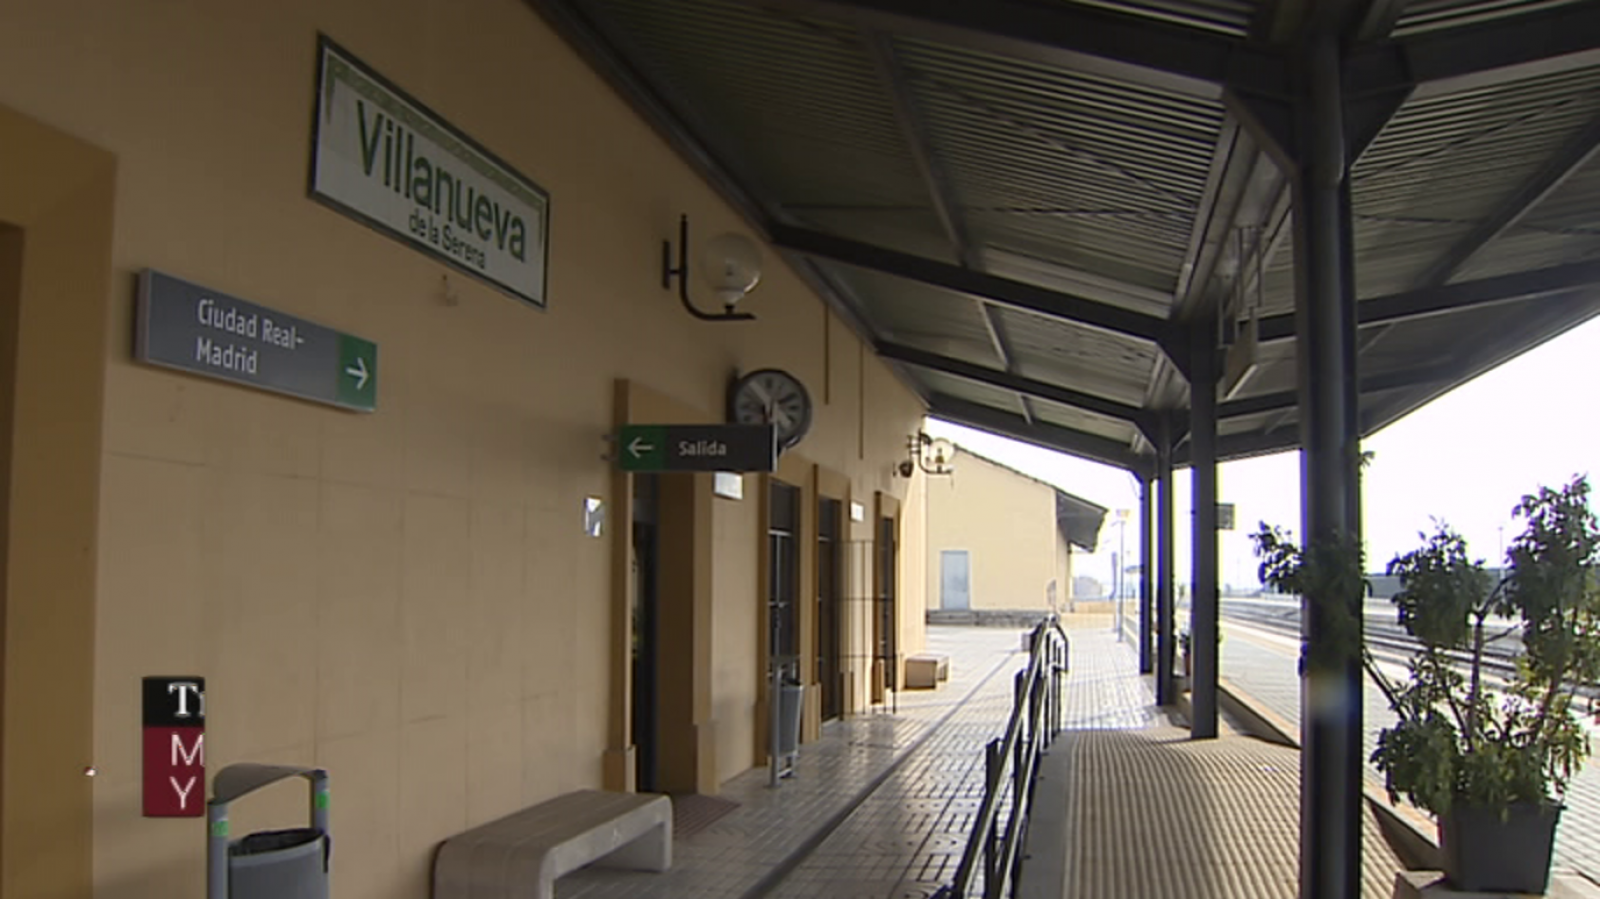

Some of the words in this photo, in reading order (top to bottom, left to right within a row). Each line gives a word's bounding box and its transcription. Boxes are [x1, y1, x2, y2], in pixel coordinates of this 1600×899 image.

[356, 99, 526, 263] Villanueva
[408, 208, 427, 238] de
[428, 214, 439, 245] la
[442, 224, 485, 270] Serena
[198, 298, 258, 338] Ciudad
[262, 317, 304, 350] Real-
[196, 336, 258, 374] Madrid
[678, 440, 728, 457] Salida
